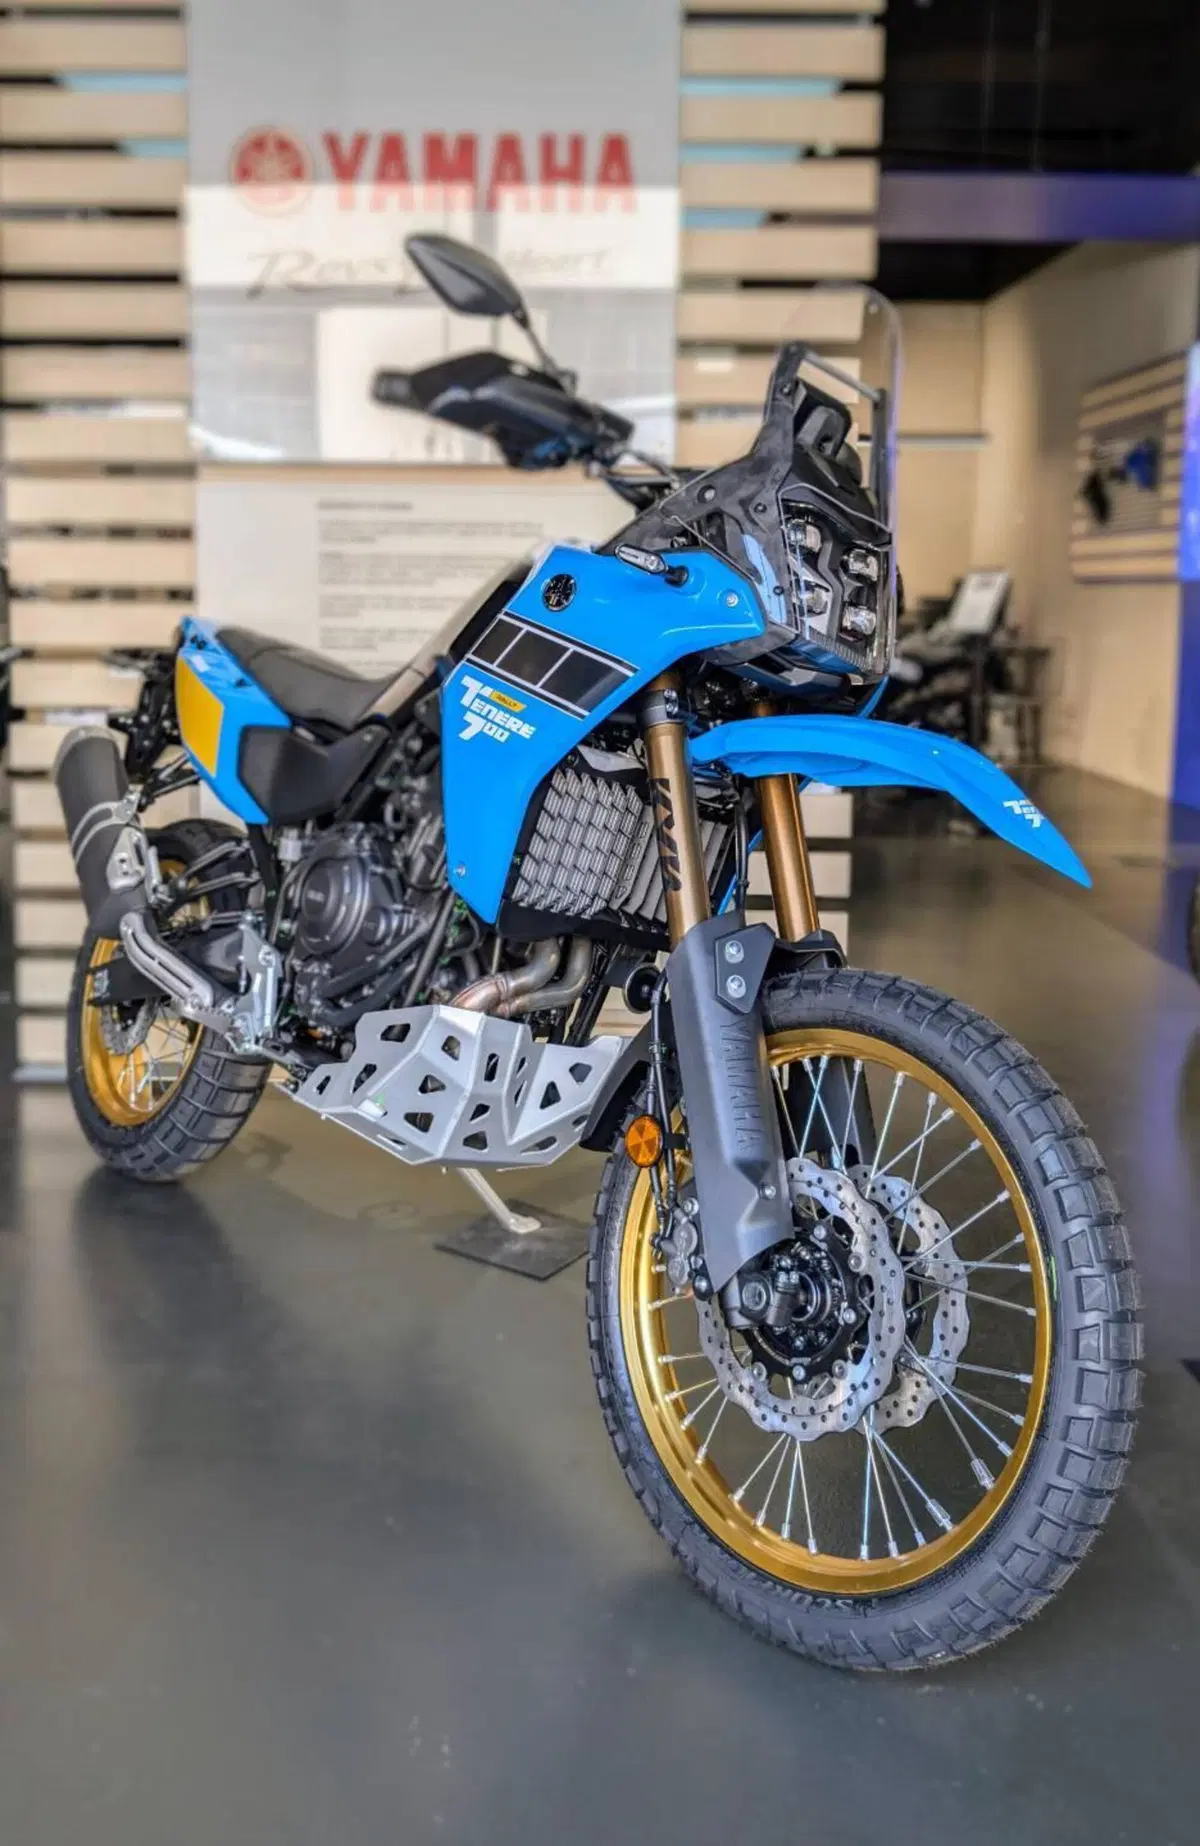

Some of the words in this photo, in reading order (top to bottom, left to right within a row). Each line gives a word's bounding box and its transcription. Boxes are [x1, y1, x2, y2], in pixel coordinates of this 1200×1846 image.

[321, 130, 638, 213] YAMAHA
[459, 710, 511, 743] 700
[719, 1017, 768, 1151] YAMAHA
